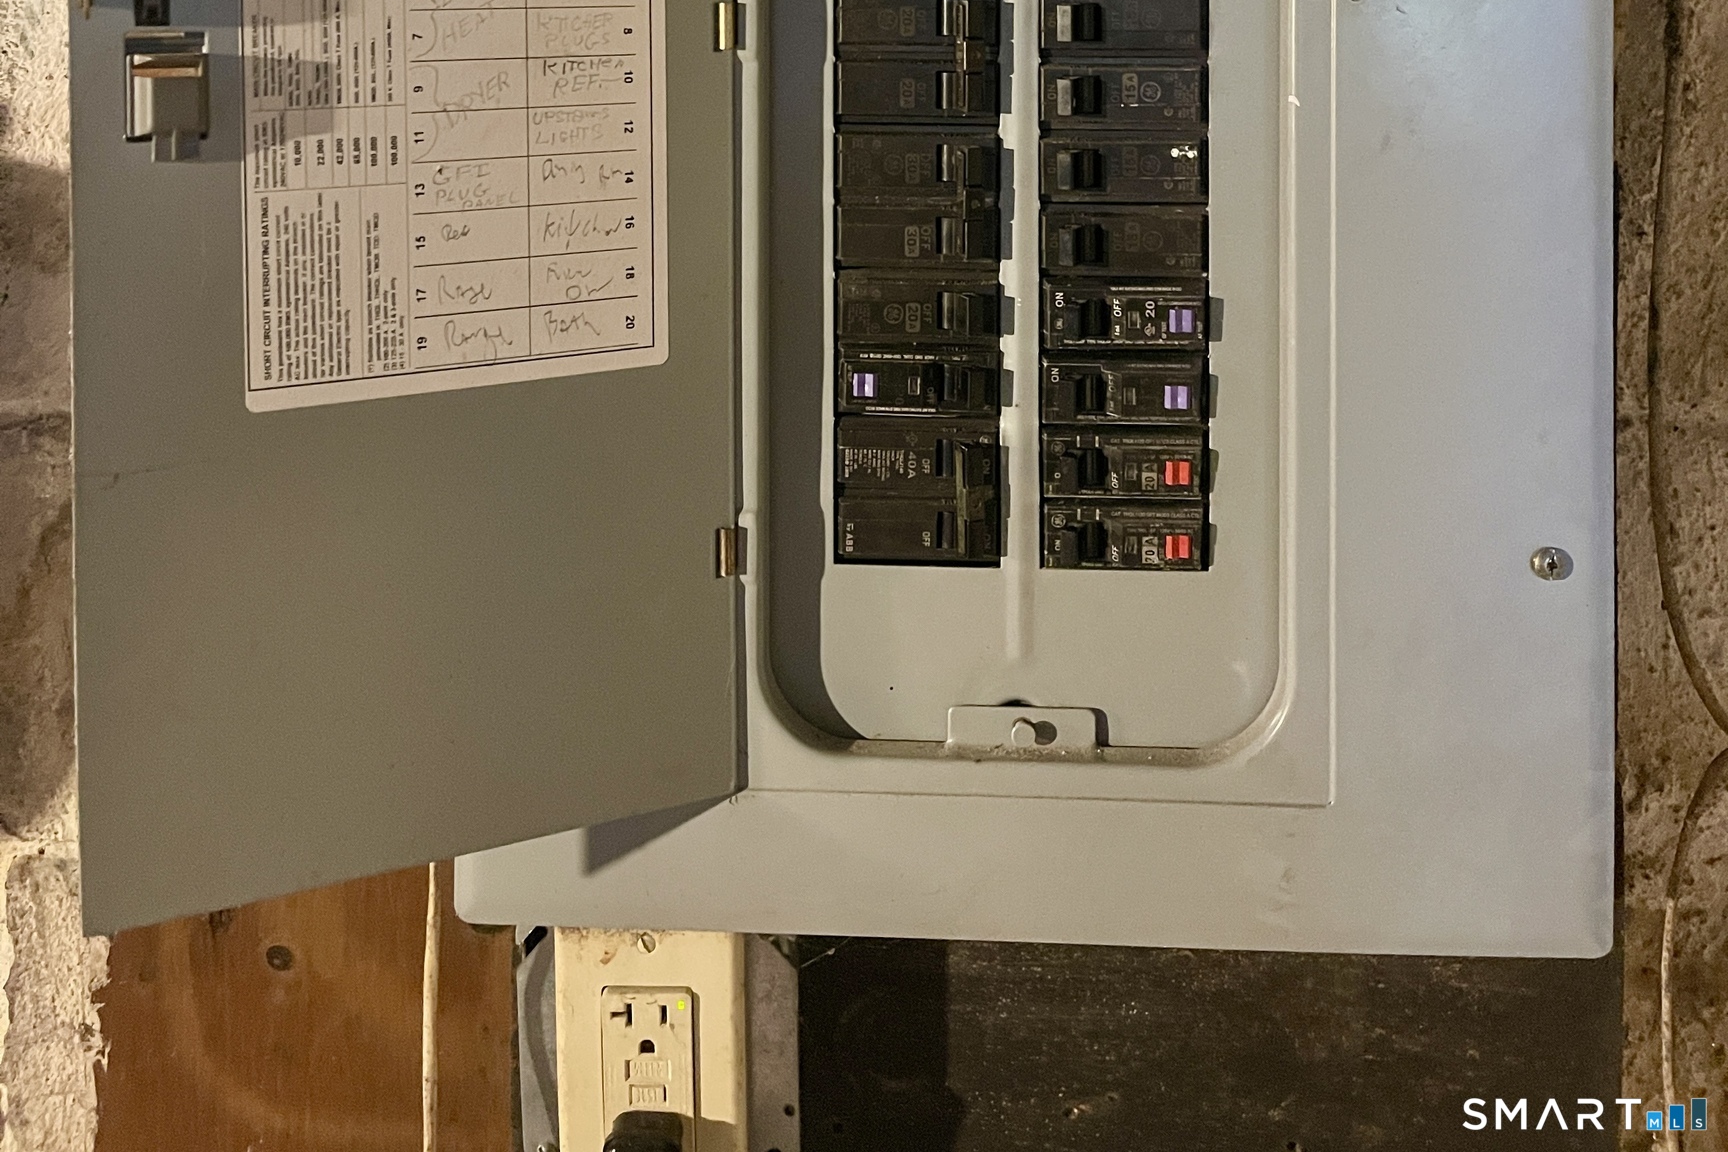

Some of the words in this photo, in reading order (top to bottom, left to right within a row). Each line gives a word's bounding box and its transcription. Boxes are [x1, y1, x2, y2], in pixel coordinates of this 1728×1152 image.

[624, 70, 633, 83] 10
[1126, 76, 1136, 98] 15A
[624, 120, 633, 133] 12
[414, 132, 424, 144] 11
[535, 126, 604, 144] LIGHTS
[432, 164, 491, 184] GFI
[625, 170, 634, 183] 14
[415, 184, 425, 197] 13
[436, 183, 490, 206] PLUG
[261, 198, 269, 237] RATINGS
[625, 216, 634, 229] 16
[415, 236, 425, 250] 15
[907, 228, 918, 254] 30A
[921, 226, 930, 250] OFF
[262, 240, 270, 307] INTERRUPTING
[626, 266, 635, 279] 18
[416, 289, 426, 302] 17
[1056, 292, 1064, 307] ON
[1114, 299, 1122, 316] OFF
[1146, 302, 1155, 318] 20
[626, 316, 635, 329] 20
[908, 306, 918, 330] 20A
[263, 310, 271, 347] CIRCUIT
[417, 337, 427, 350] 19
[264, 350, 272, 381] SHORT
[1052, 368, 1059, 382] ON
[1108, 374, 1116, 392] OFF
[908, 452, 916, 478] 40A
[922, 459, 930, 474] OFF
[922, 532, 930, 546] OFF
